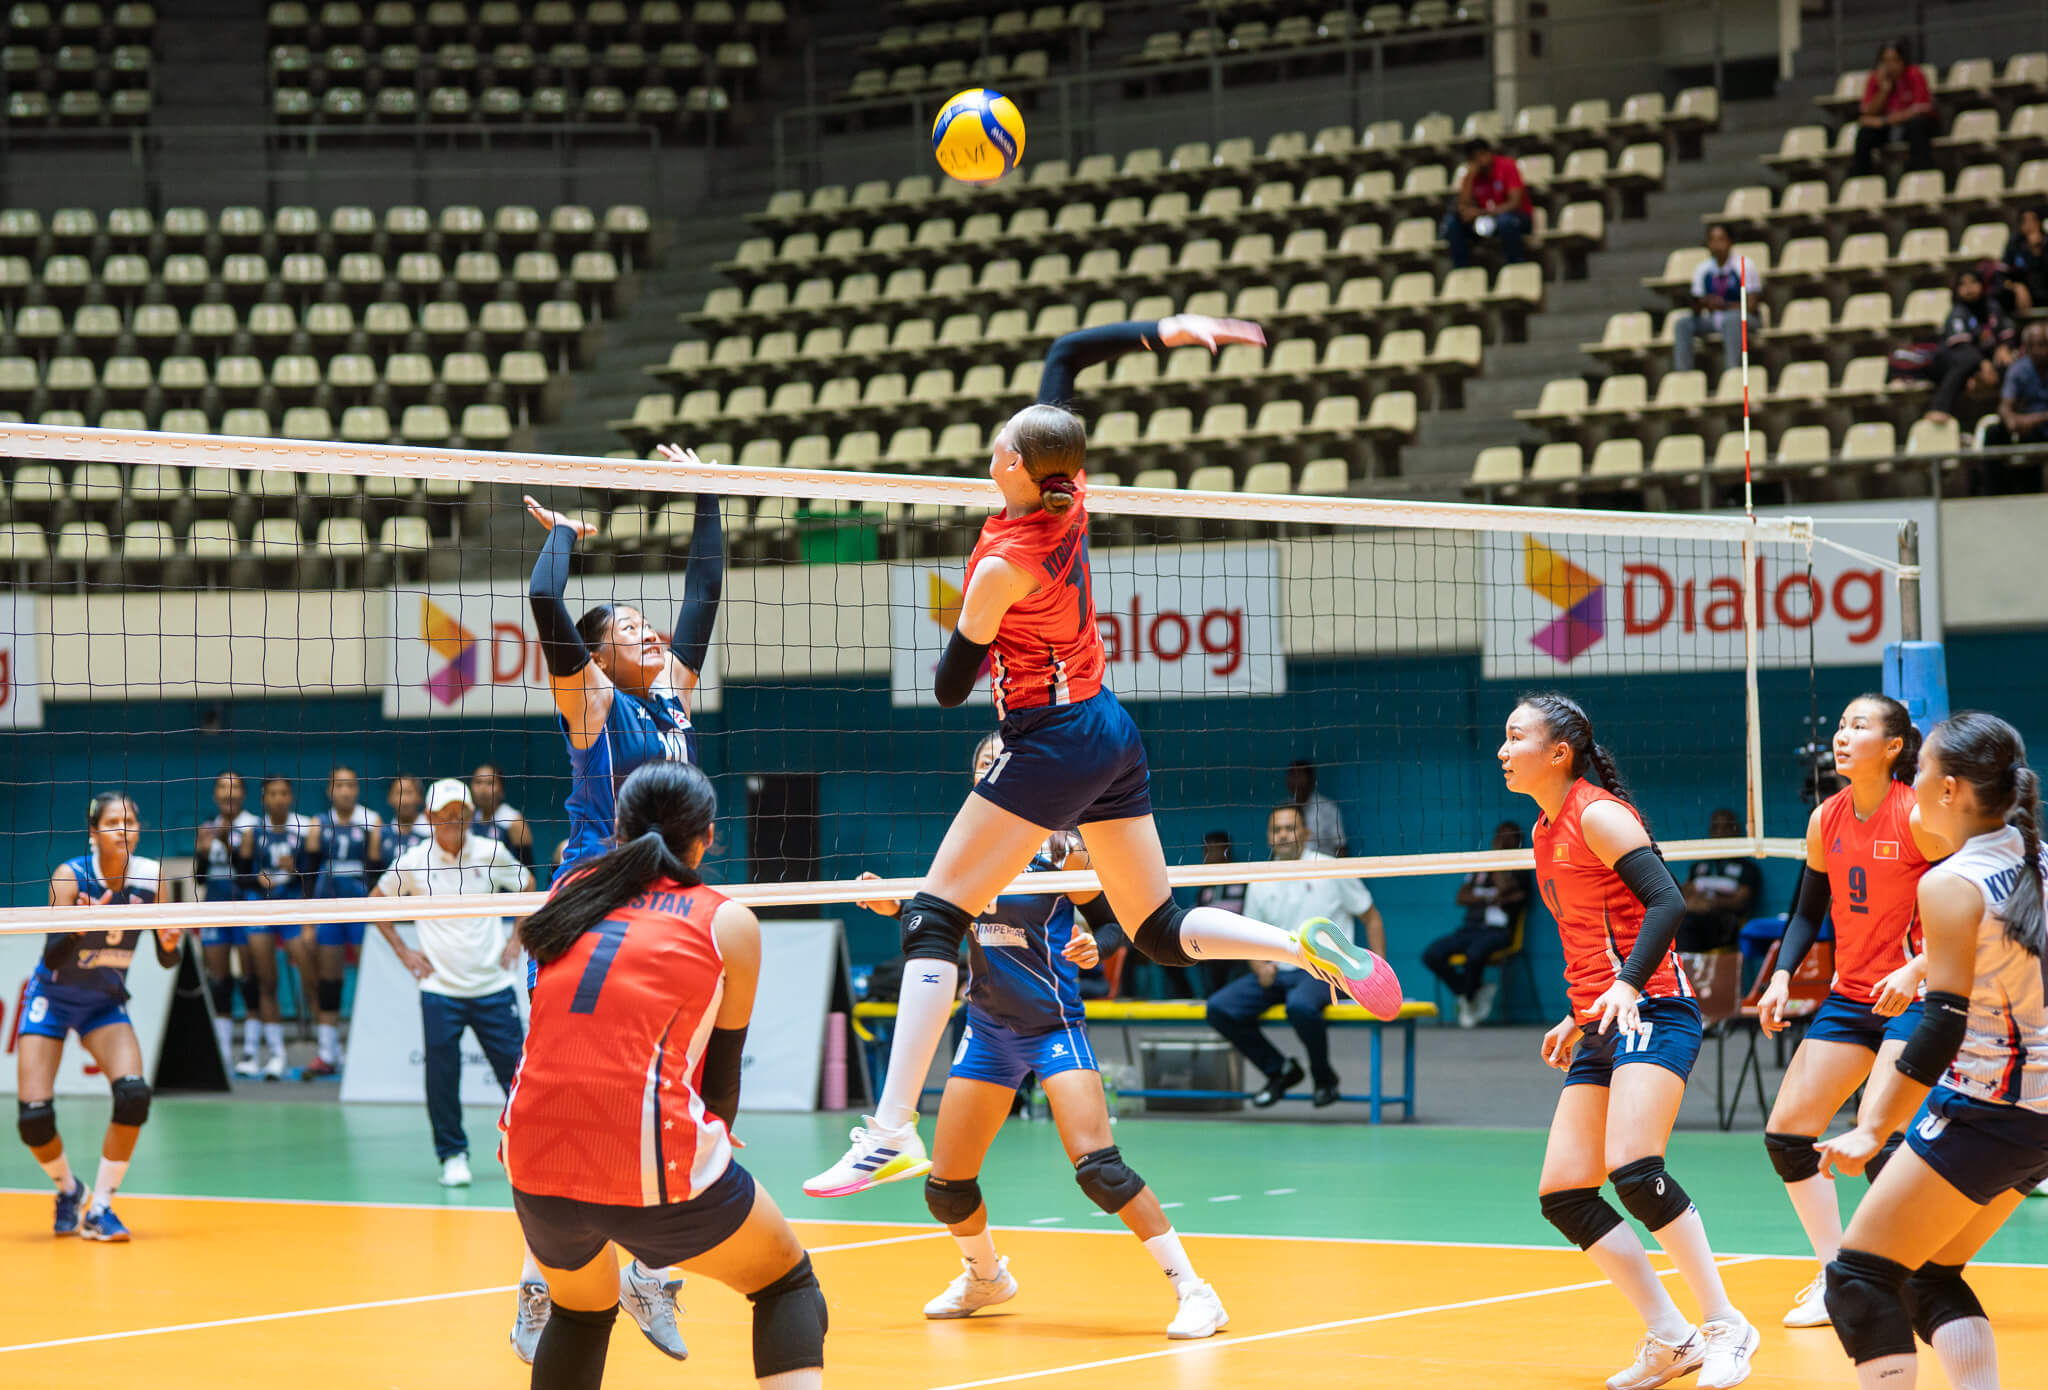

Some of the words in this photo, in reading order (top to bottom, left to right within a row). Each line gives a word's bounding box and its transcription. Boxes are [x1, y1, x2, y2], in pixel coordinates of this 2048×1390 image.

[1094, 593, 1243, 677] alog
[1622, 556, 1884, 644] Dialog
[1848, 865, 1868, 903] 9
[568, 919, 630, 1014] 7
